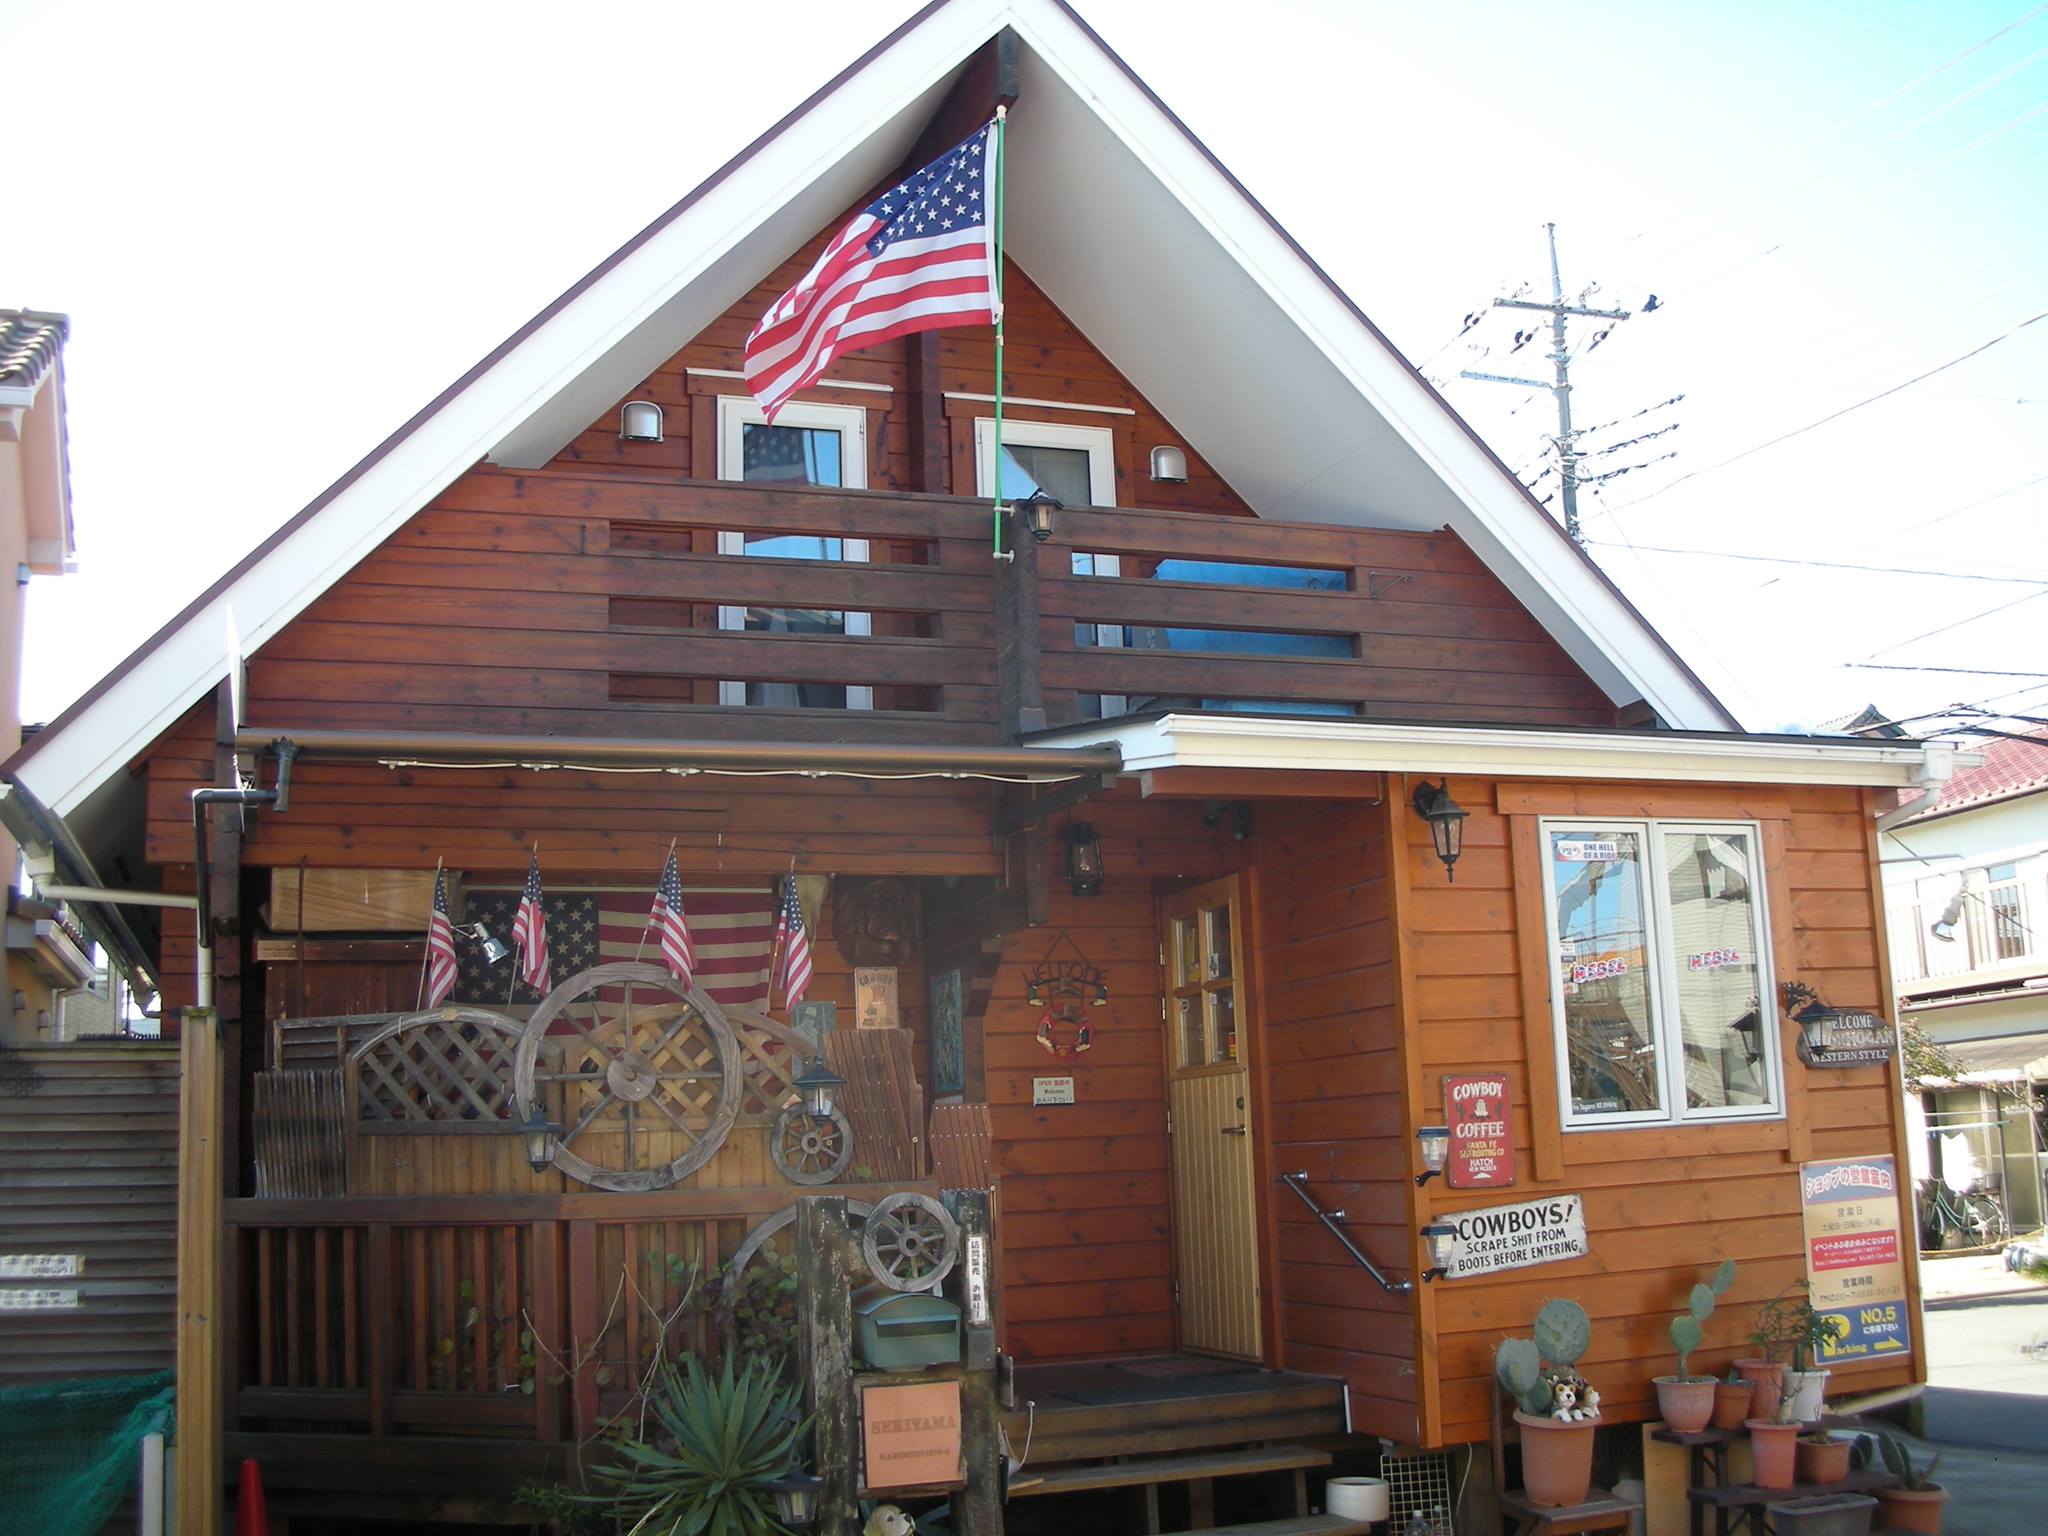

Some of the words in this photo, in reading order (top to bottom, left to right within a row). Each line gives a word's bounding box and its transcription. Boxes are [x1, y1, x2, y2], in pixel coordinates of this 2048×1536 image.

[1583, 843, 1597, 851] ONE
[1599, 844, 1614, 852] HELL
[1689, 948, 1740, 971] REBEL
[1022, 960, 1110, 987] WELCOME
[1573, 957, 1627, 983] REBEL
[1810, 1050, 1858, 1063] WESTERN
[1859, 1049, 1888, 1059] STYLE
[1453, 1082, 1503, 1100] COWBOY
[1456, 1121, 1505, 1138] COFFEE
[1489, 1140, 1498, 1148] FE
[1470, 1158, 1494, 1167] HATCH
[1806, 1165, 1892, 1199] ショップの営業案内
[1459, 1203, 1574, 1241] COWBOYS!
[1466, 1239, 1508, 1254] SCRAPE
[1511, 1234, 1533, 1247] SHIT
[1536, 1228, 1566, 1243] FROM
[1458, 1255, 1491, 1272] BOOTS
[1494, 1247, 1528, 1265] BEFORE
[1841, 1275, 1873, 1288] 営業時間
[1861, 1306, 1896, 1324] NO.5
[872, 1416, 956, 1434] SEKIYAMA
